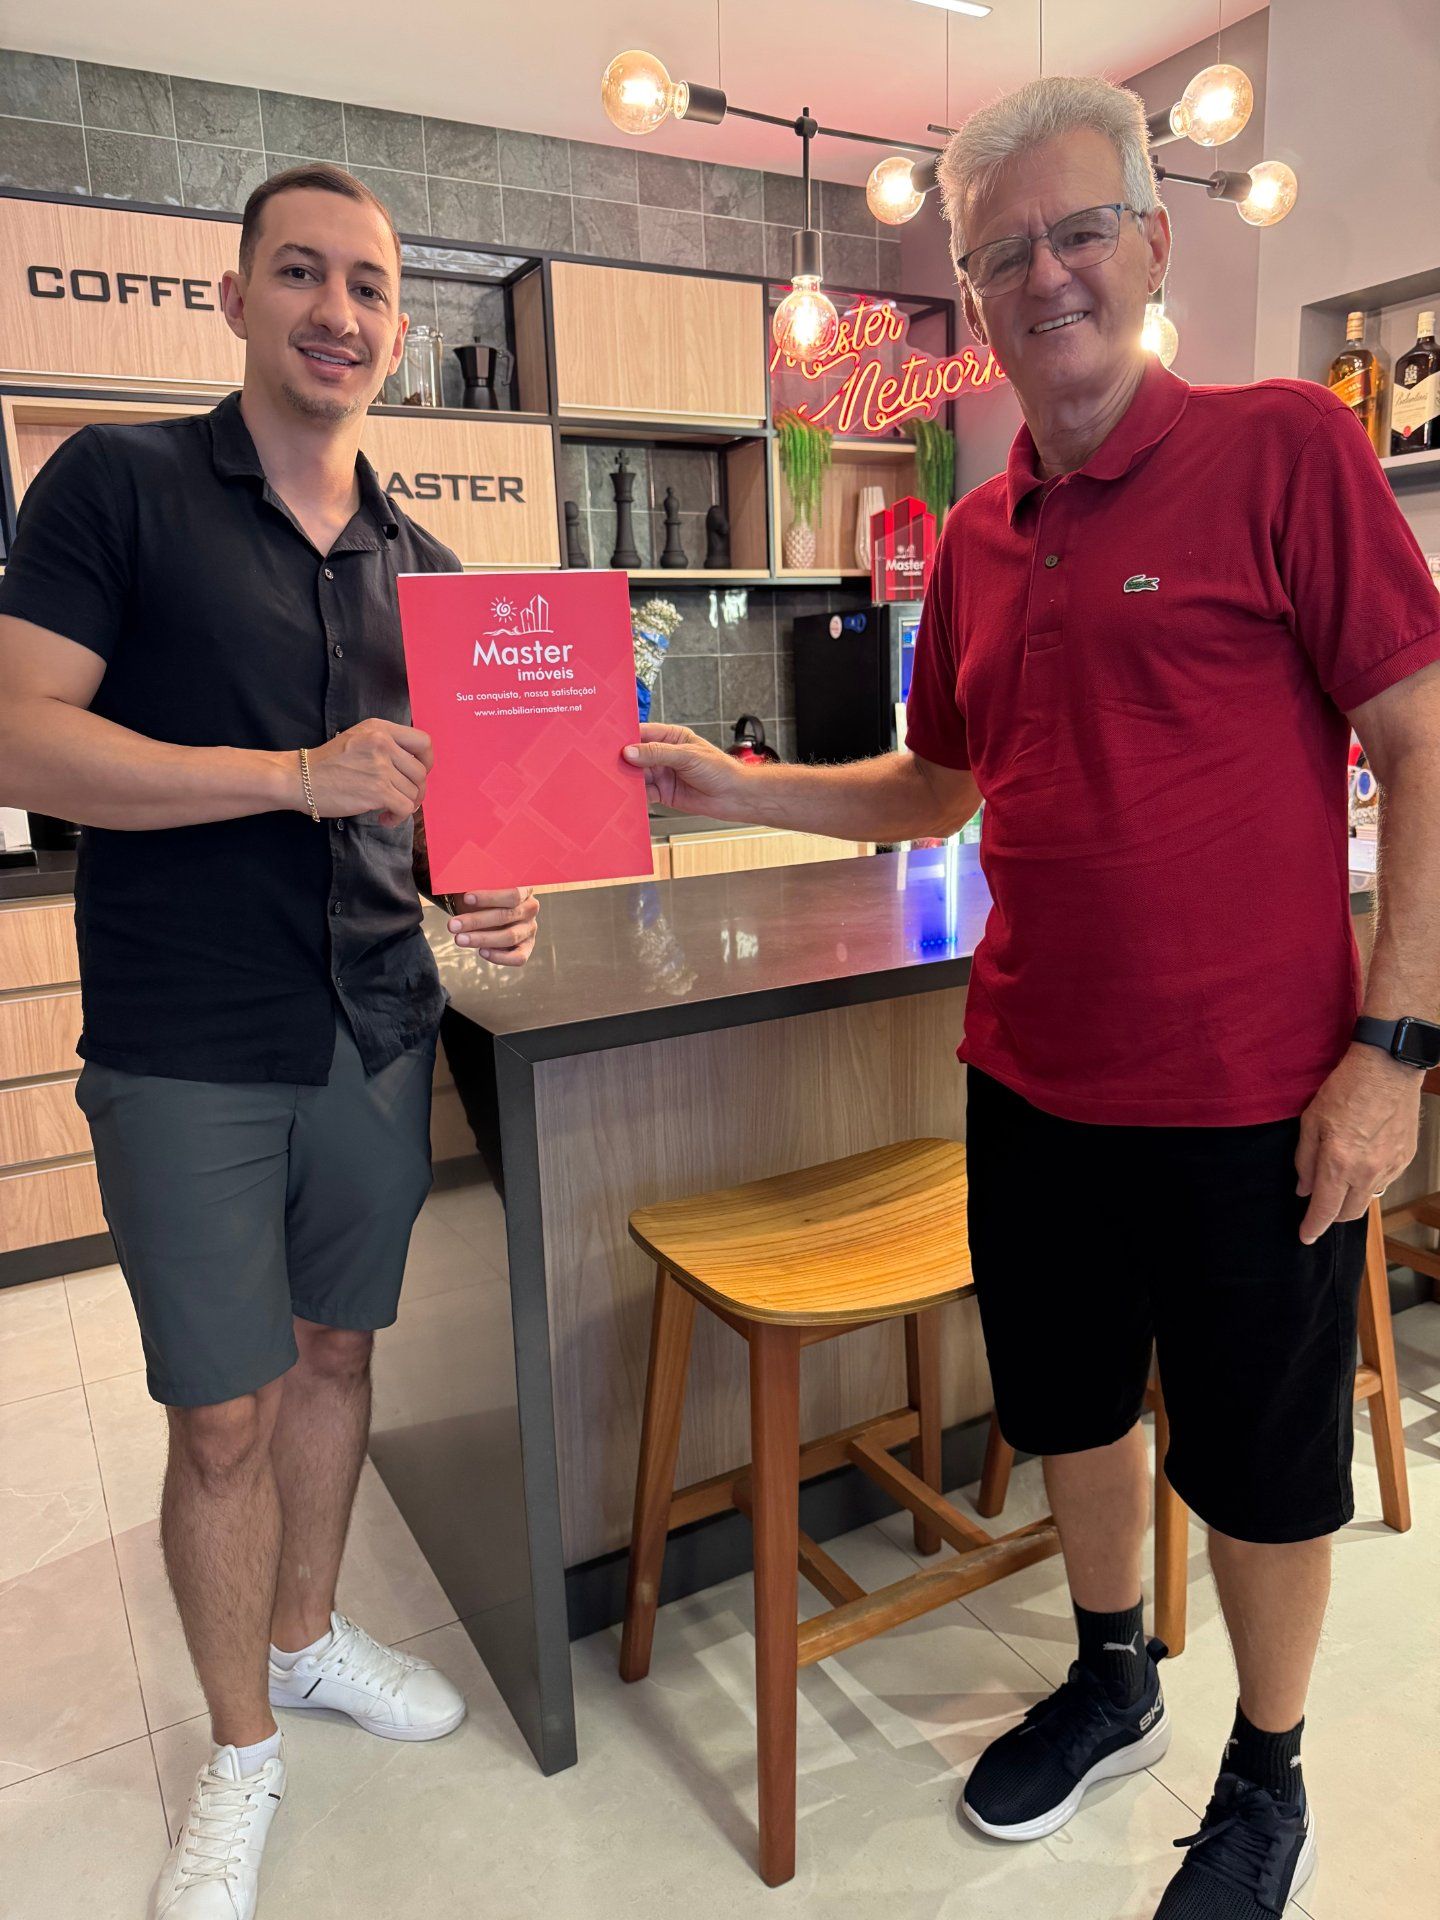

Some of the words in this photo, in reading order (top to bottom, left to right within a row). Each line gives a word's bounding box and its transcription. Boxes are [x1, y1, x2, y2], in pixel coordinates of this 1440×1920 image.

[27, 265, 223, 312] COFFE
[375, 471, 526, 504] ASTER
[885, 558, 925, 572] Master
[472, 639, 574, 667] Master
[517, 666, 574, 682] imóveis
[456, 692, 474, 702] Sua
[476, 690, 521, 702] conquista,
[524, 689, 549, 698] nossa
[551, 685, 596, 697] satisfação!
[474, 704, 582, 717] www.imobiliariamaster.net
